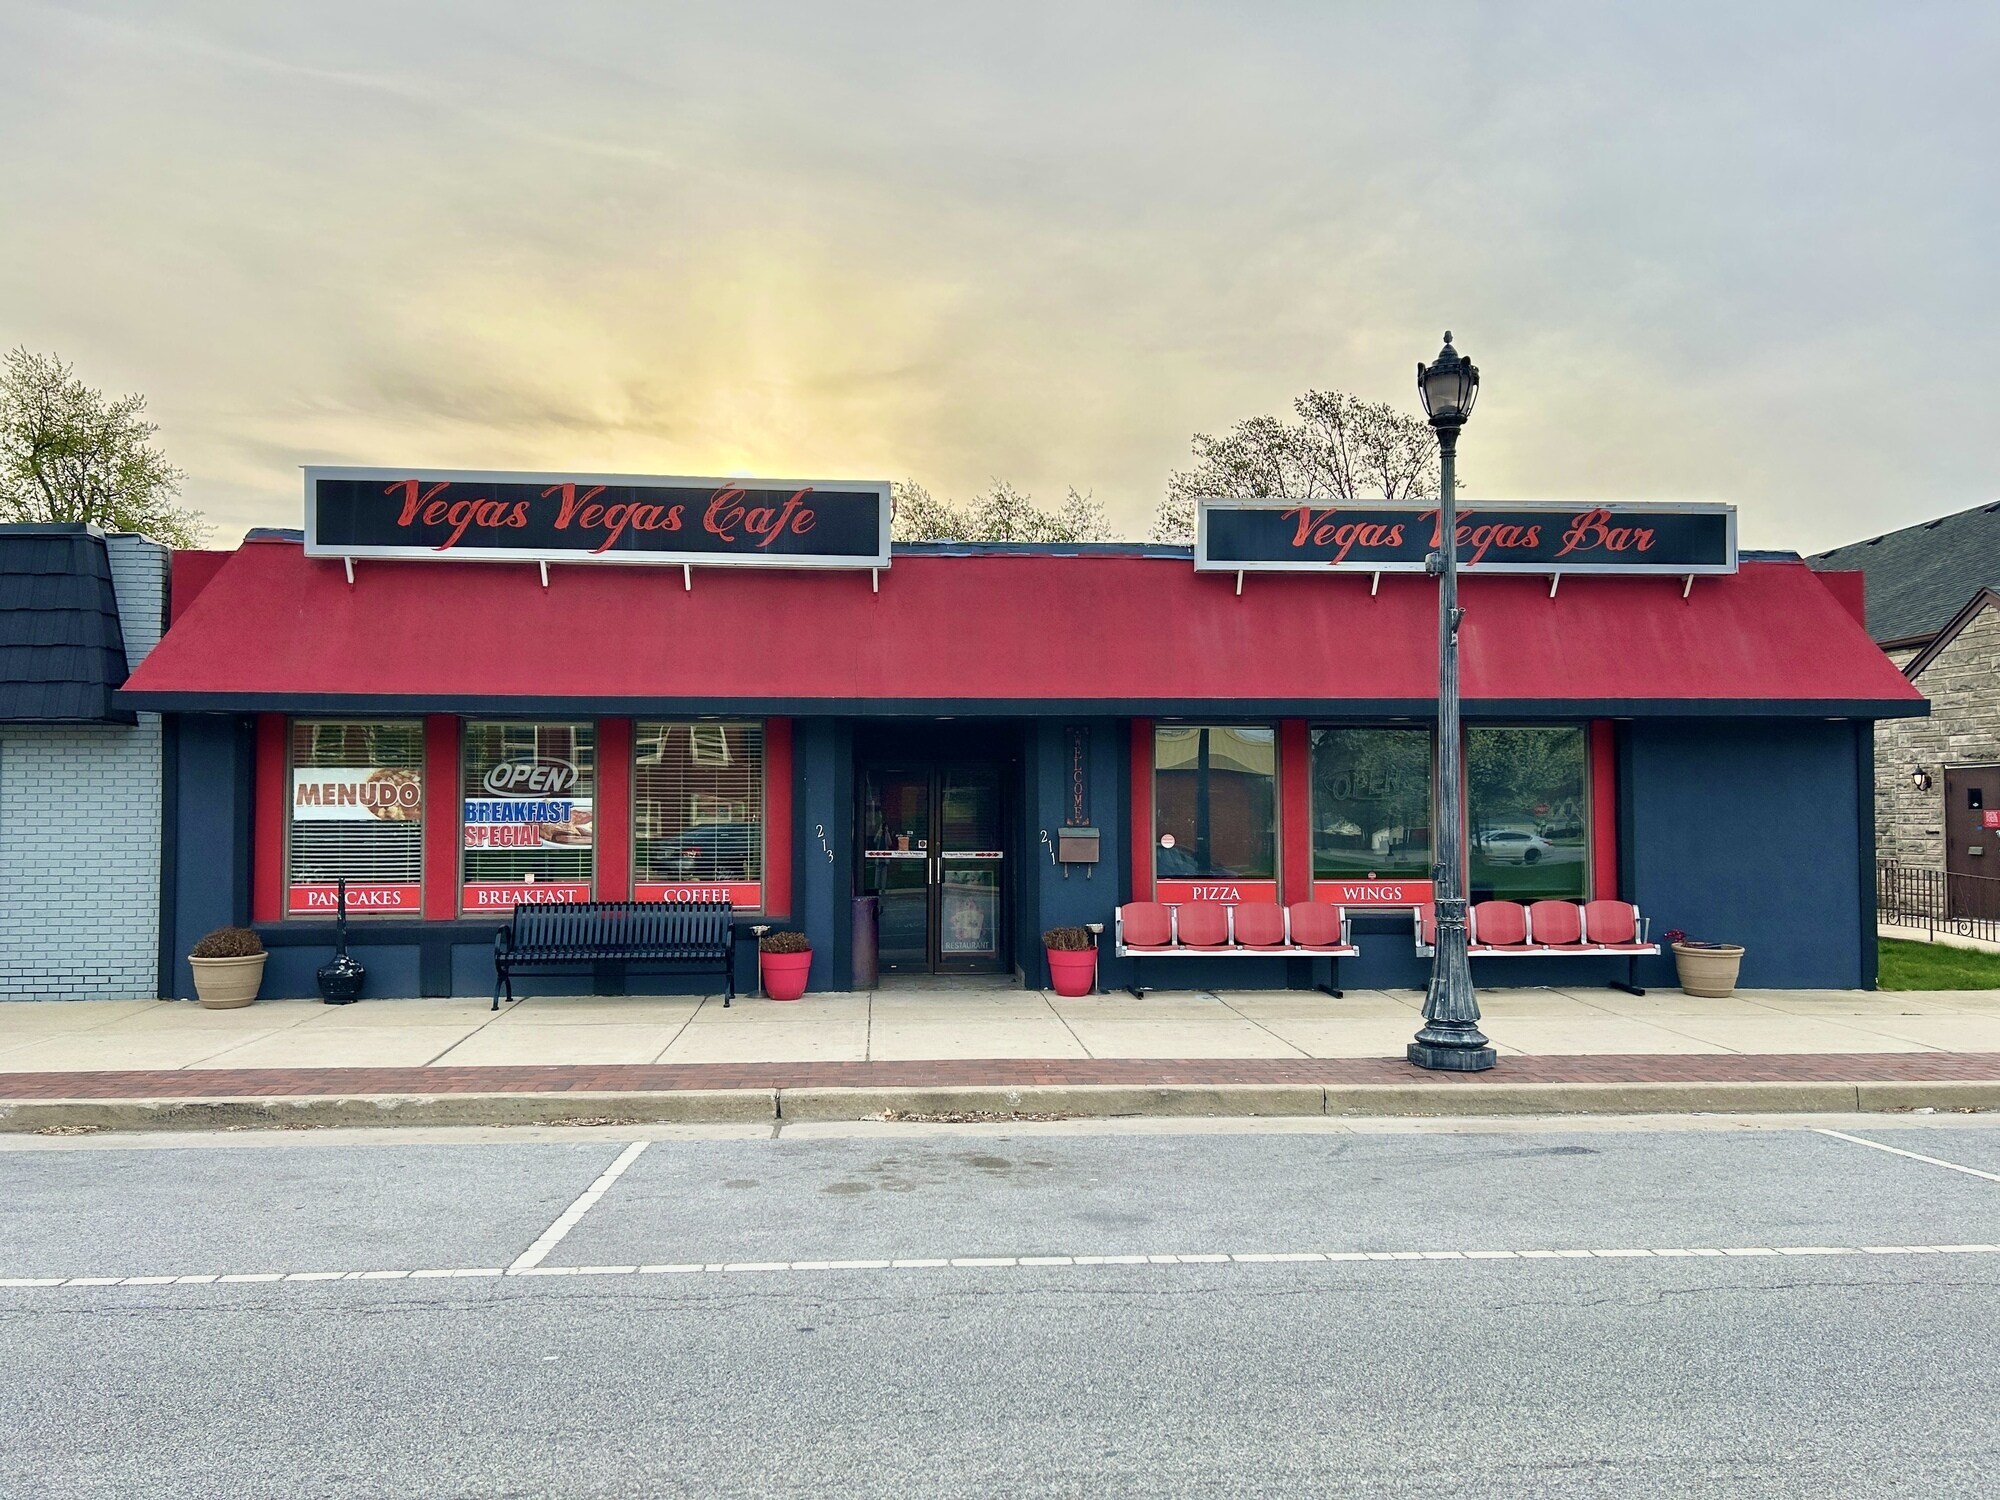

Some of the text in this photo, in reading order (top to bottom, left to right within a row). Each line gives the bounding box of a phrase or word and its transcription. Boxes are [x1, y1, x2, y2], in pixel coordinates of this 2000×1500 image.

[384, 479, 817, 554] Vegas Vegas Cafe
[1280, 506, 1656, 566] Vegas Vegas Bar
[489, 763, 569, 792] OPEN
[1073, 735, 1083, 819] WELCOME
[296, 782, 420, 807] MENUDO
[465, 801, 573, 823] BREAKFAST
[465, 825, 542, 847] SPECIAL
[815, 824, 834, 864] 213
[1040, 829, 1056, 865] 211
[307, 890, 401, 906] PANCAKES
[477, 889, 577, 905] BREAKFAST
[663, 888, 731, 903] COFFEE
[1192, 886, 1241, 900] PIZZA
[1343, 887, 1402, 900] WINGS
[945, 942, 989, 950] RESTAURANT
